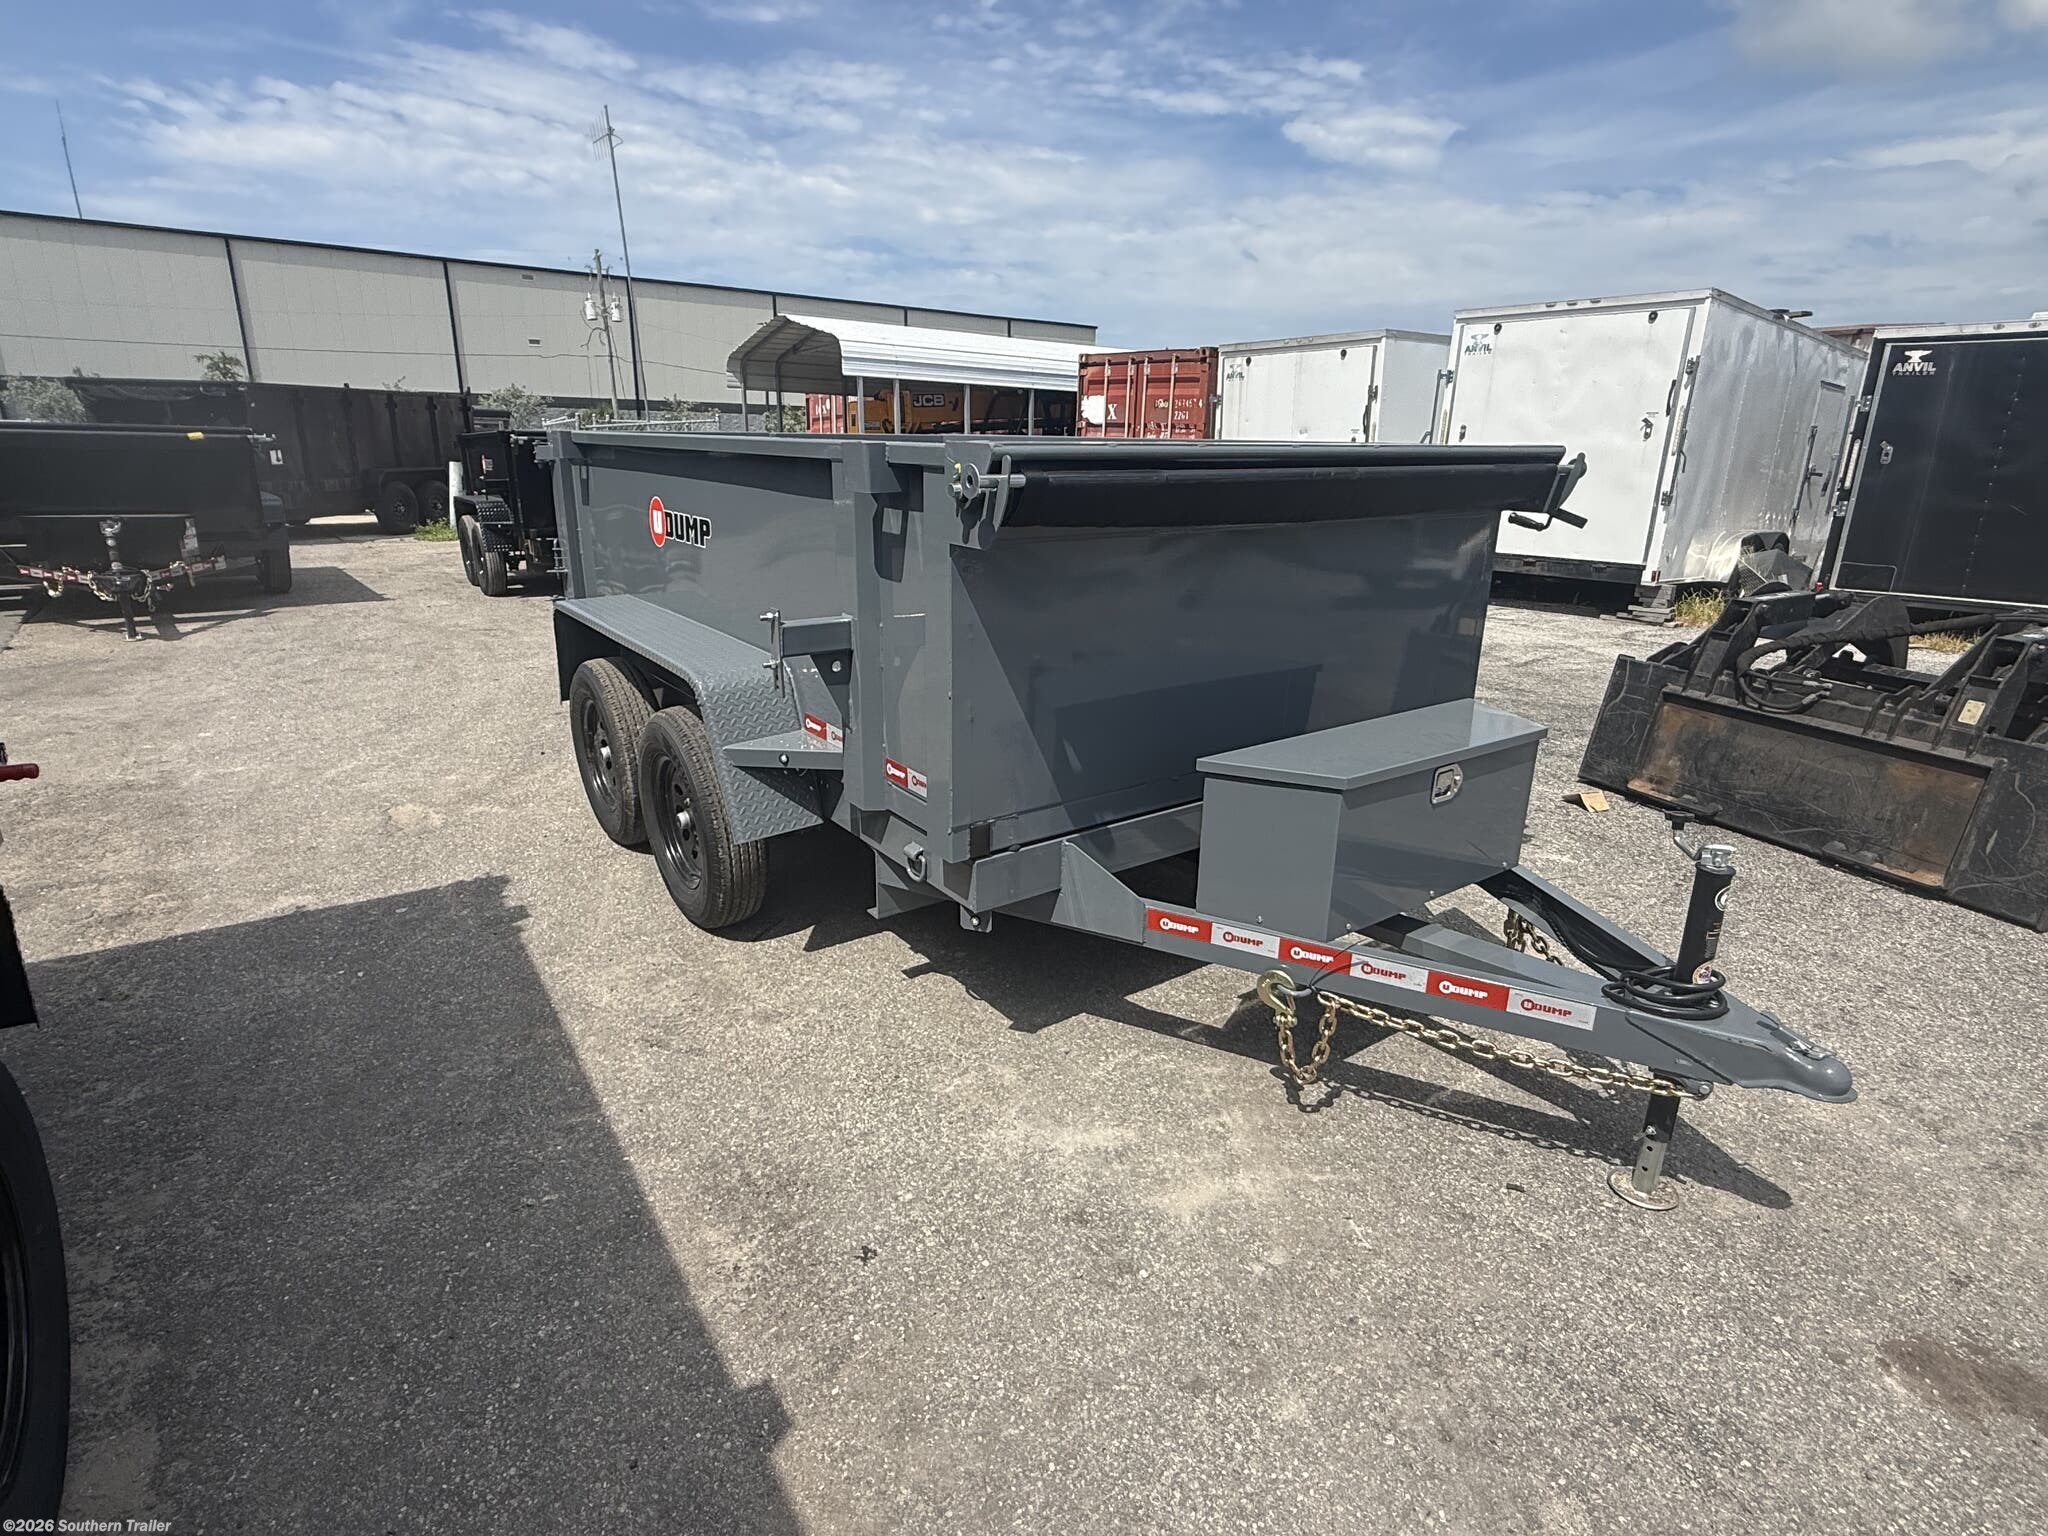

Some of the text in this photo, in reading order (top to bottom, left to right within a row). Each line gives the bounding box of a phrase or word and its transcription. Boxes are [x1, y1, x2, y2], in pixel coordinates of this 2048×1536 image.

[1464, 344, 1492, 353] ANVIL
[1892, 362, 1937, 371] ANVIL
[913, 394, 945, 407] JCB
